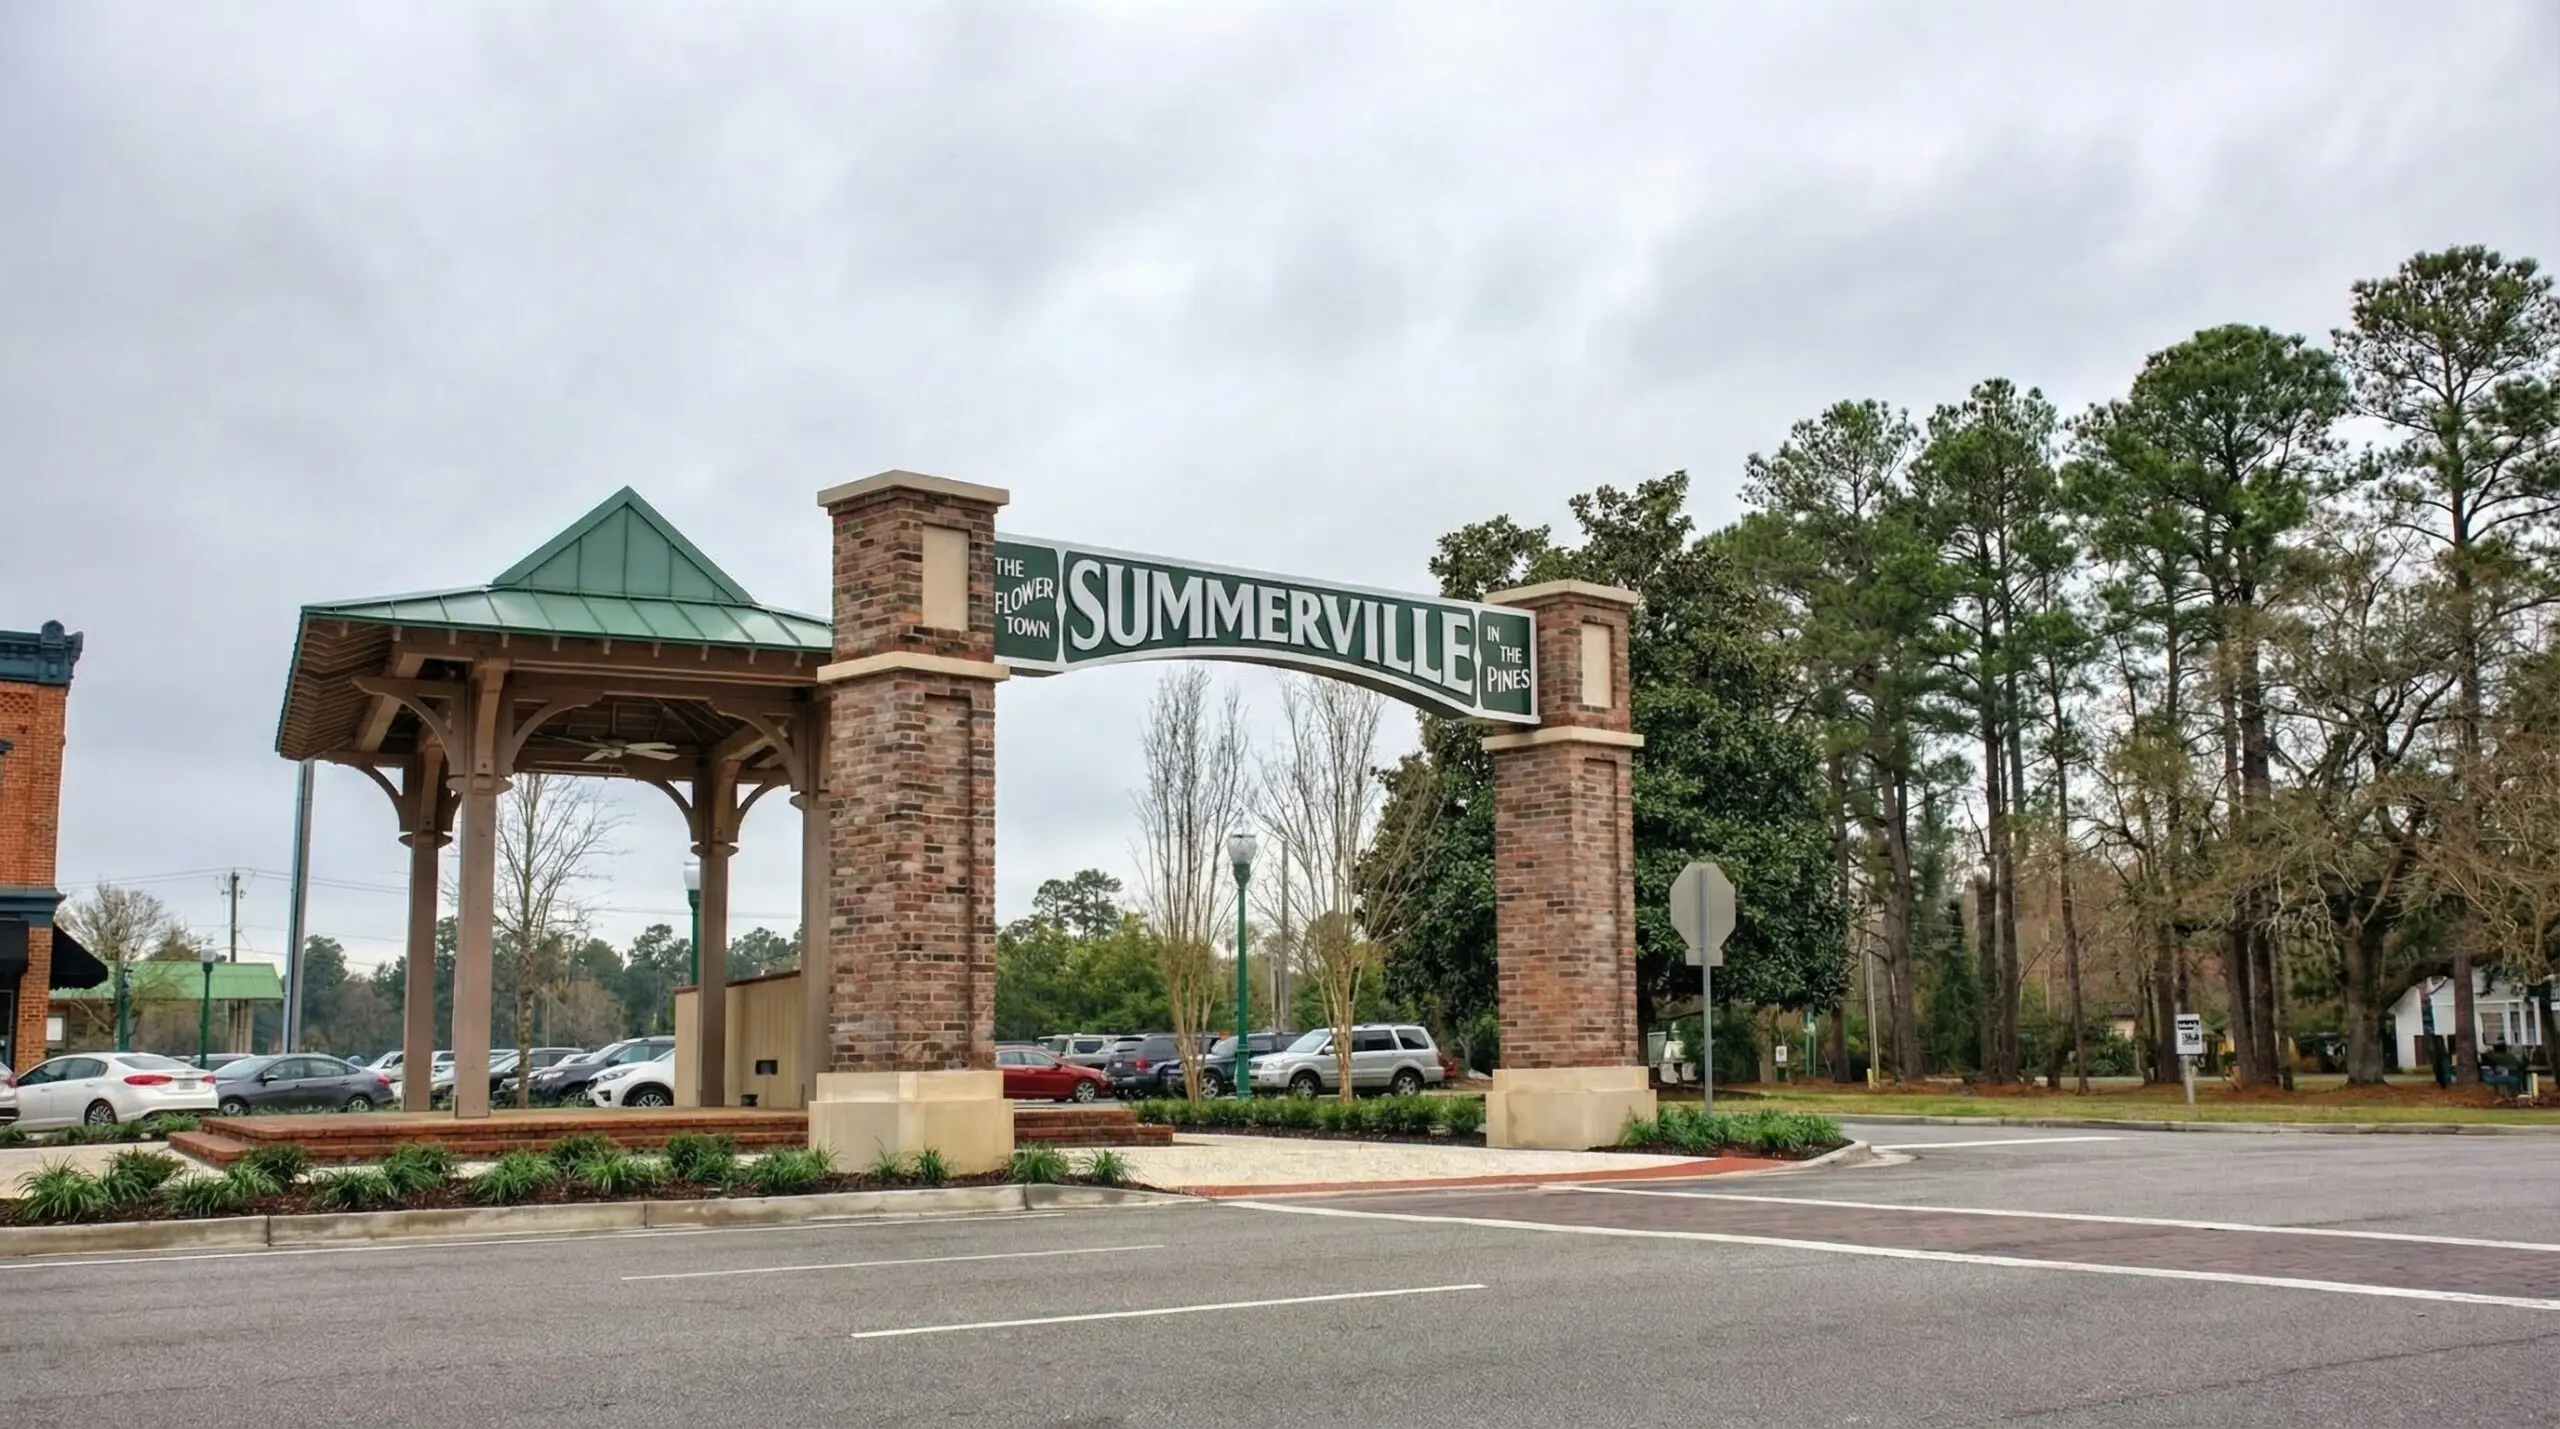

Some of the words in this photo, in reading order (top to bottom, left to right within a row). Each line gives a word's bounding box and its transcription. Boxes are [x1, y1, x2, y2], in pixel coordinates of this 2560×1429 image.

[995, 557, 1024, 578] THE
[994, 577, 1054, 615] FLOWER
[1004, 616, 1050, 640] TOWN
[1069, 559, 1473, 695] SUMMERVILLE
[1487, 625, 1500, 642] IN
[1499, 645, 1523, 664] THE
[1487, 666, 1530, 693] PINES
